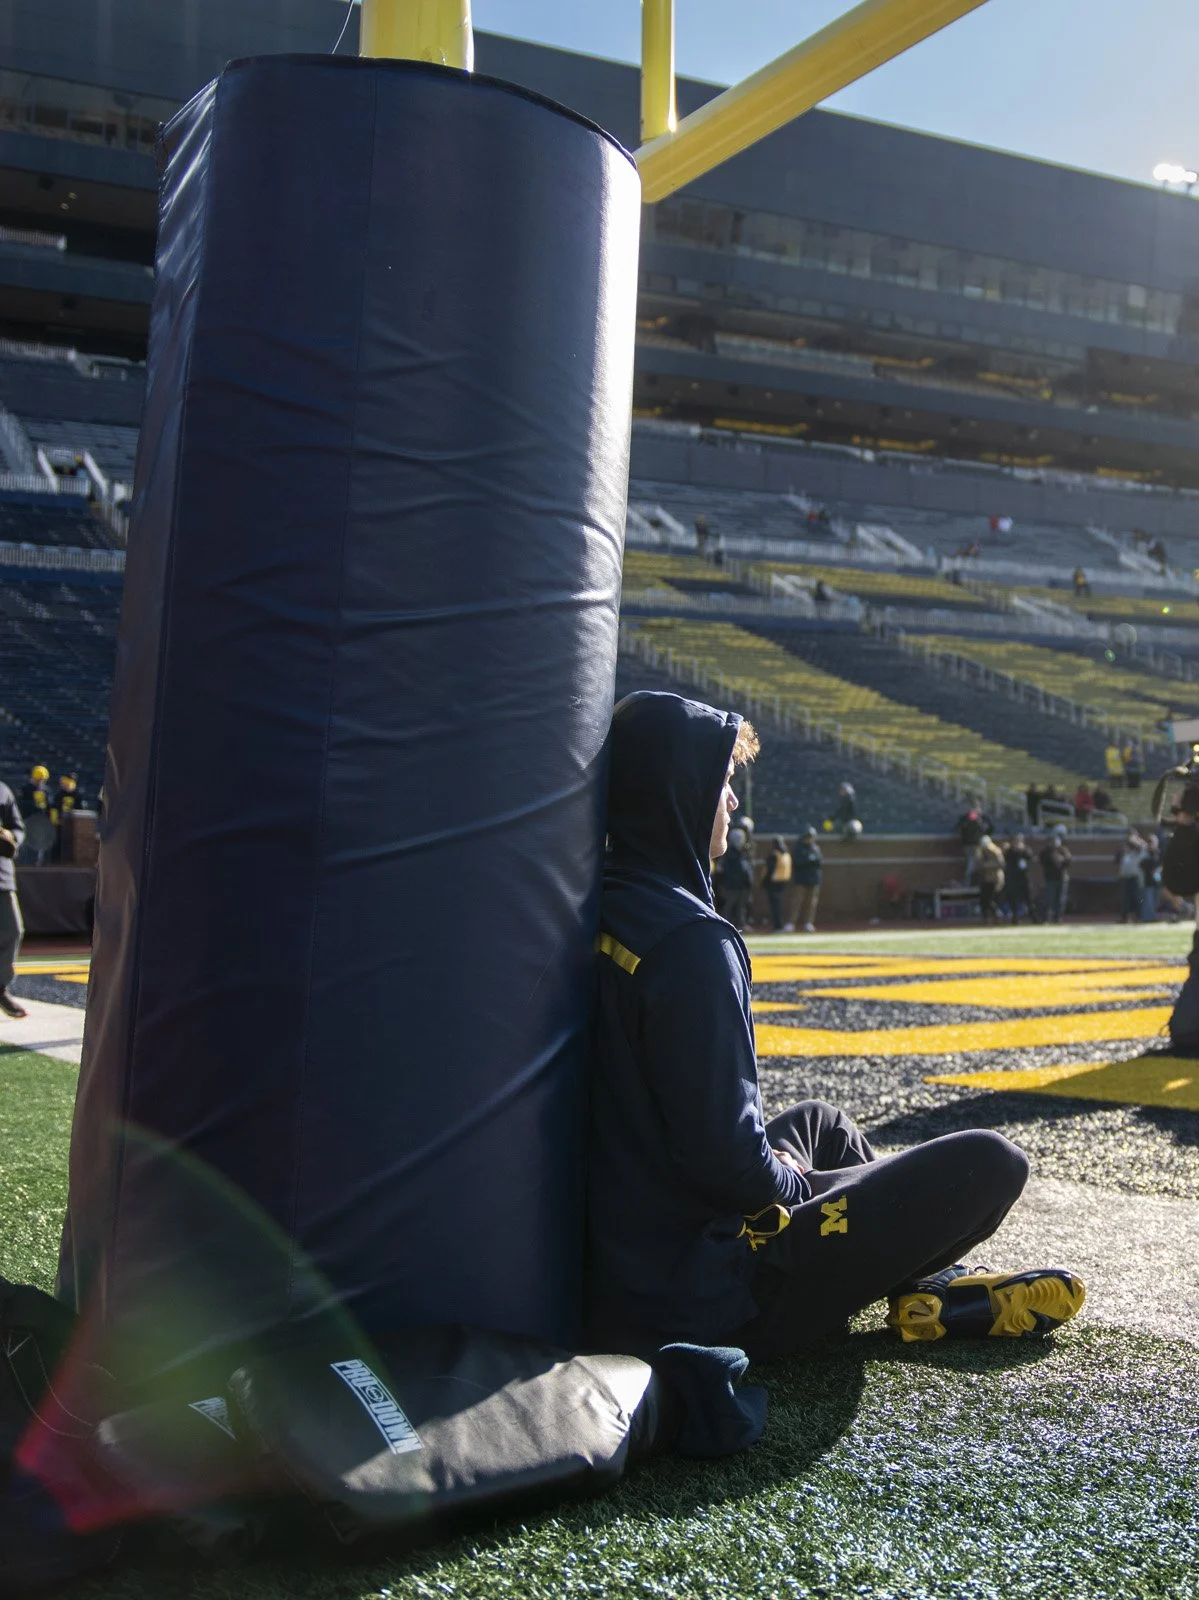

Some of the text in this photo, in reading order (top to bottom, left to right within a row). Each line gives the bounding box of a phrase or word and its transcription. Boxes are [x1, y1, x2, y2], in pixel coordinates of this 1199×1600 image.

[821, 1197, 848, 1237] M
[334, 1359, 424, 1454] PRO DOWN
